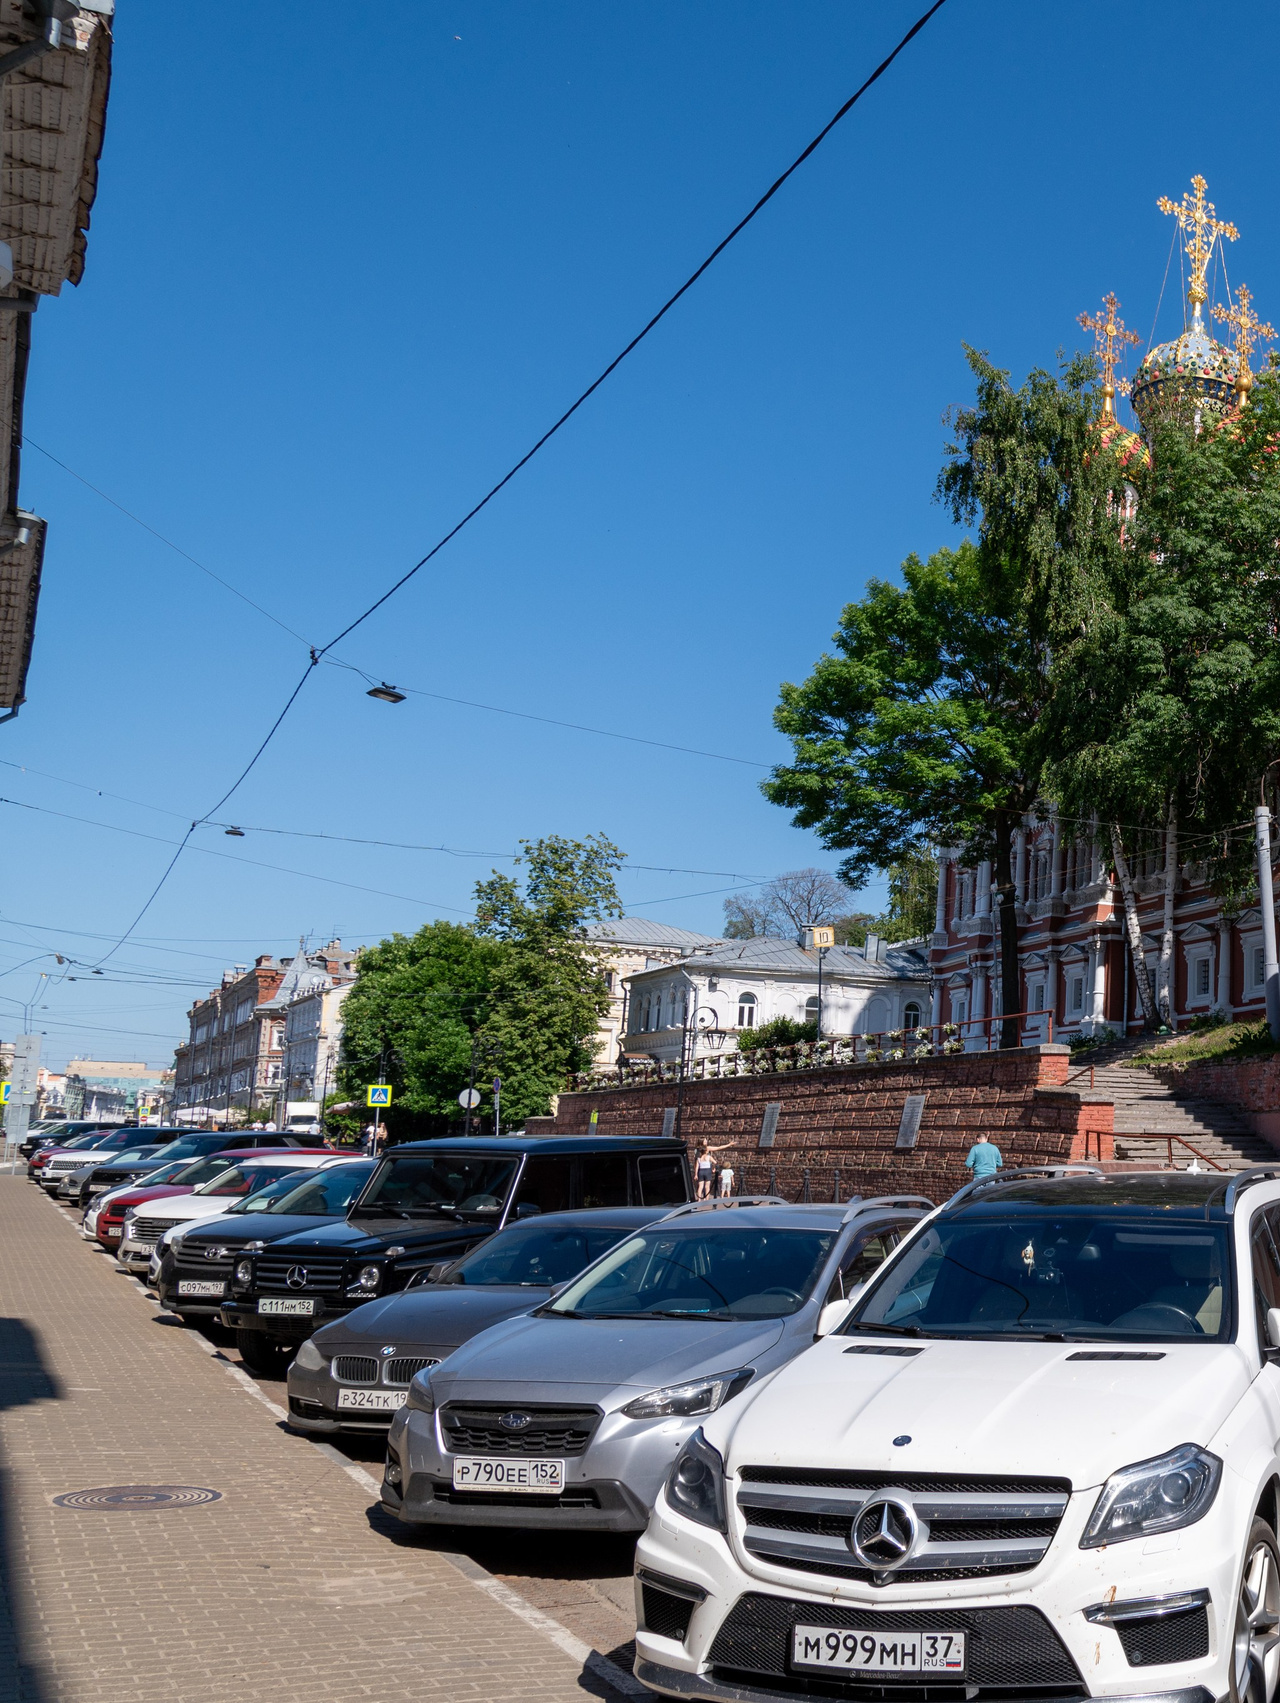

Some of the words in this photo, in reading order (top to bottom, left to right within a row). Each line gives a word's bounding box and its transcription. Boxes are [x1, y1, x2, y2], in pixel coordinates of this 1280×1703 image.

[532, 1463, 557, 1479] 152
[925, 1636, 954, 1659] 37
[923, 1658, 945, 1667] RUS
